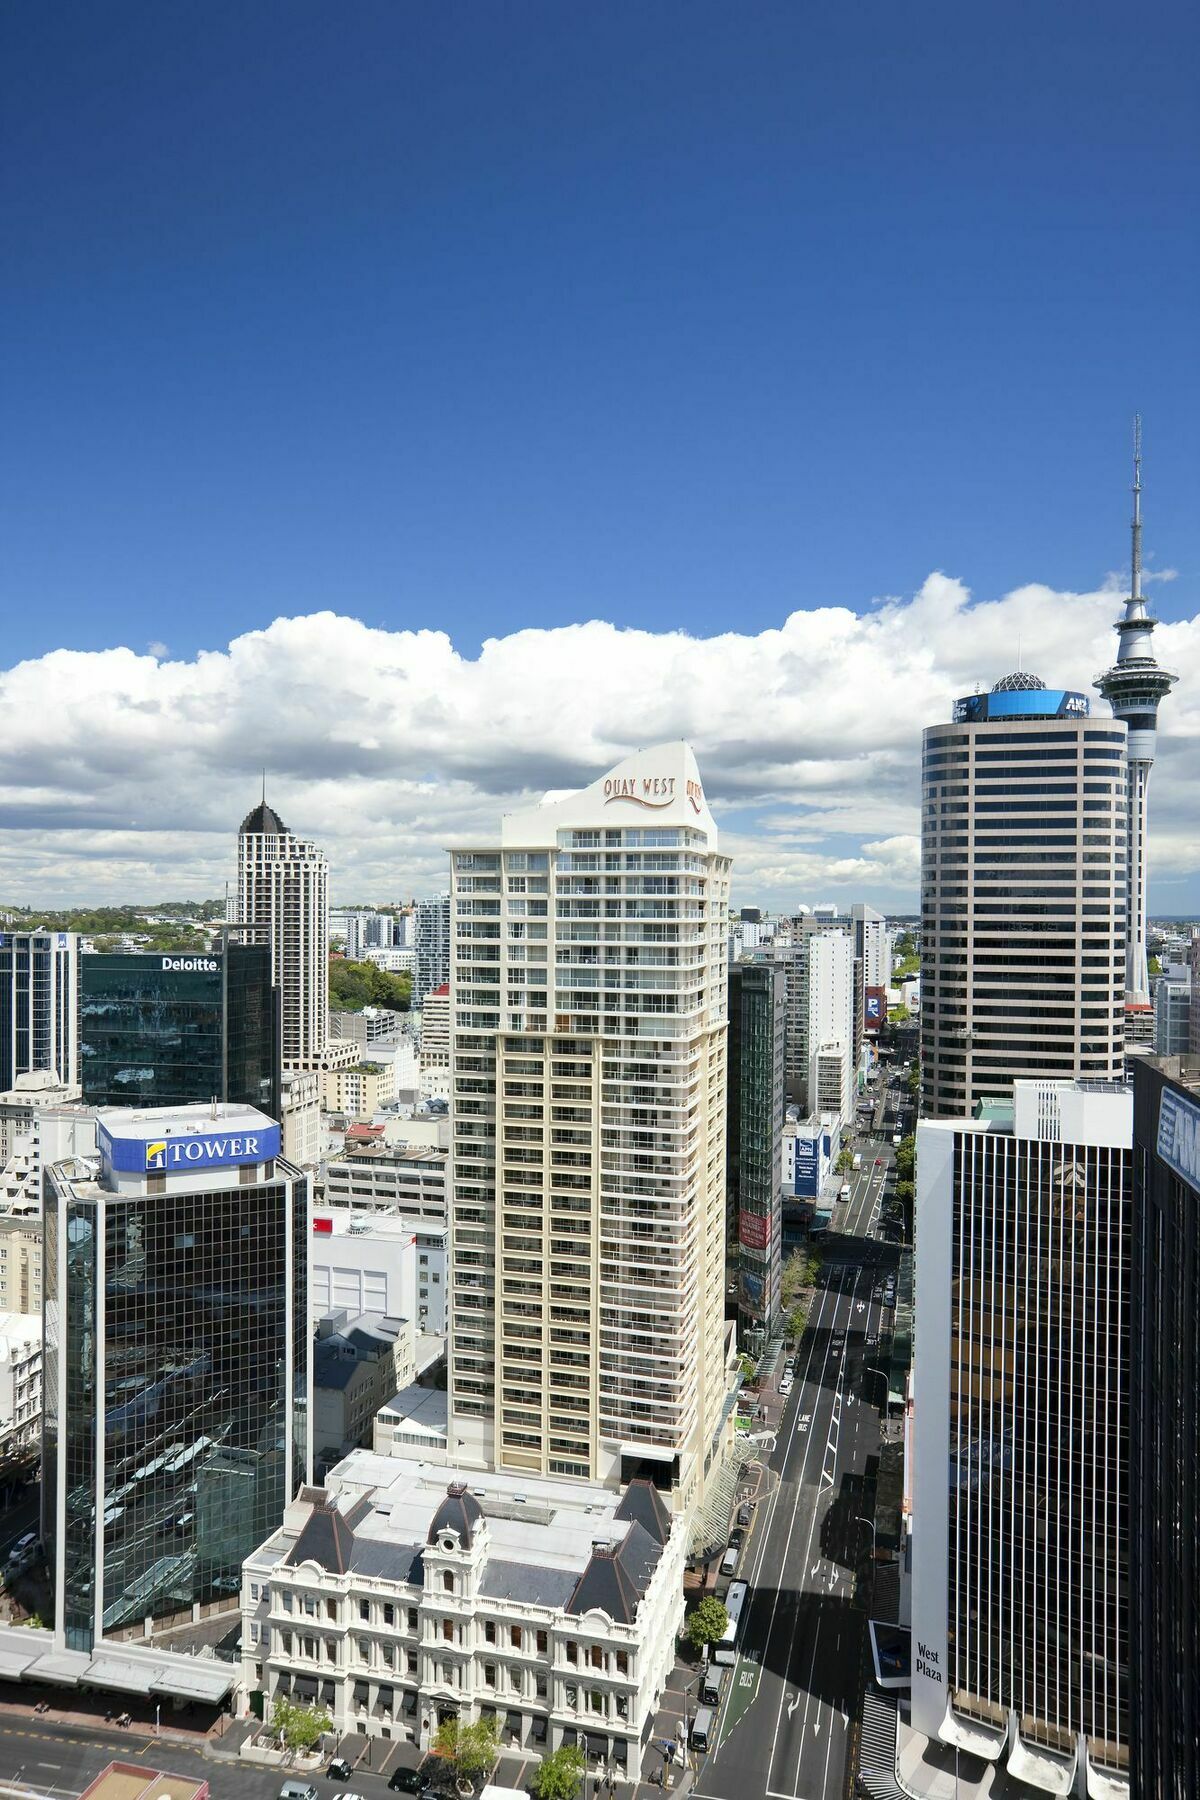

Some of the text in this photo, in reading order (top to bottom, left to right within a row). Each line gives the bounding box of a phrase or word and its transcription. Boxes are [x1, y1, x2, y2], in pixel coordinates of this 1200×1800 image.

[604, 779, 636, 796] QUAY
[643, 778, 675, 794] WEST
[162, 957, 221, 971] Deloitte.
[867, 998, 878, 1008] P
[168, 1137, 260, 1162] TOWER
[798, 1414, 812, 1423] LANE
[797, 1423, 808, 1432] BUS
[917, 1642, 939, 1664] West
[739, 1670, 755, 1687] BUS
[916, 1658, 942, 1683] Plaza
